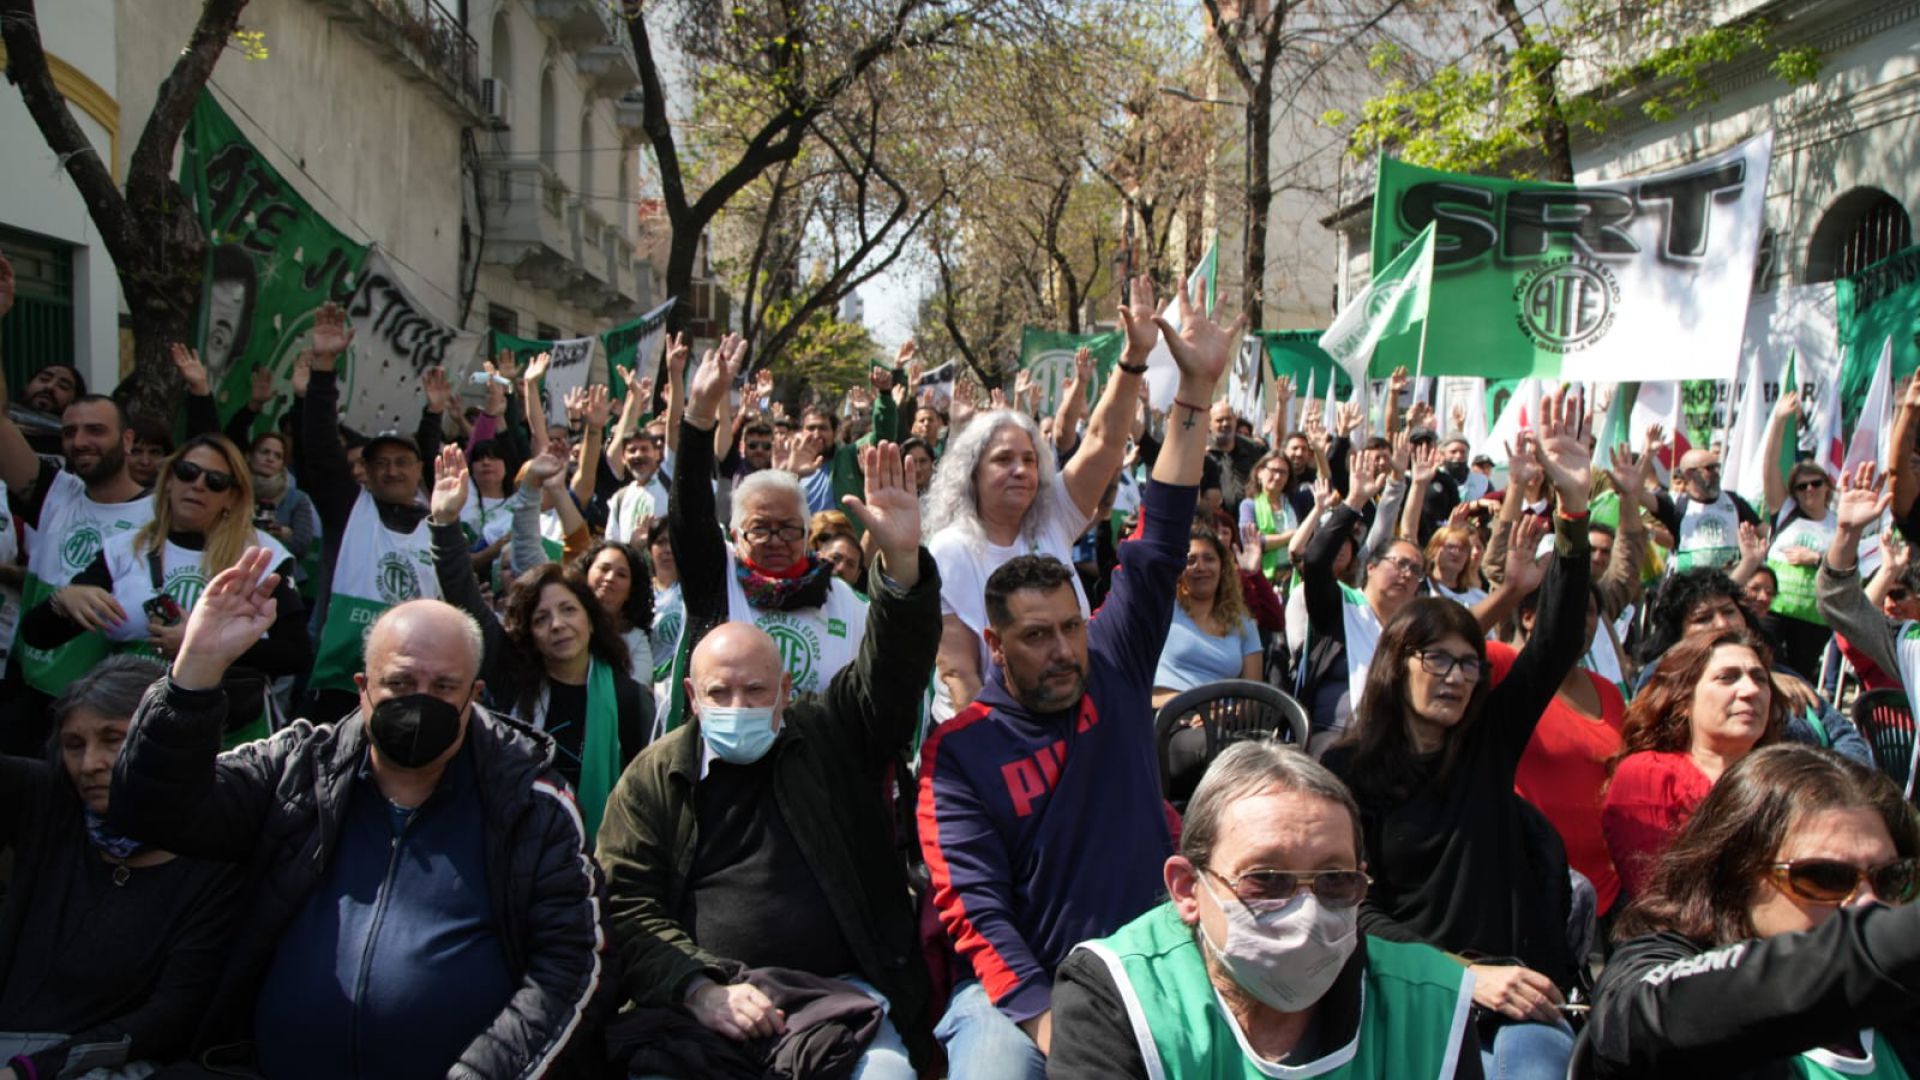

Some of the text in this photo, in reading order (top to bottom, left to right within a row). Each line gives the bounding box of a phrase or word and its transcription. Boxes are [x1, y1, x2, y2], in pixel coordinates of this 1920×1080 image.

[1399, 157, 1747, 268] SRT
[305, 247, 457, 374] JUSTICIA
[1532, 275, 1601, 337] ATE
